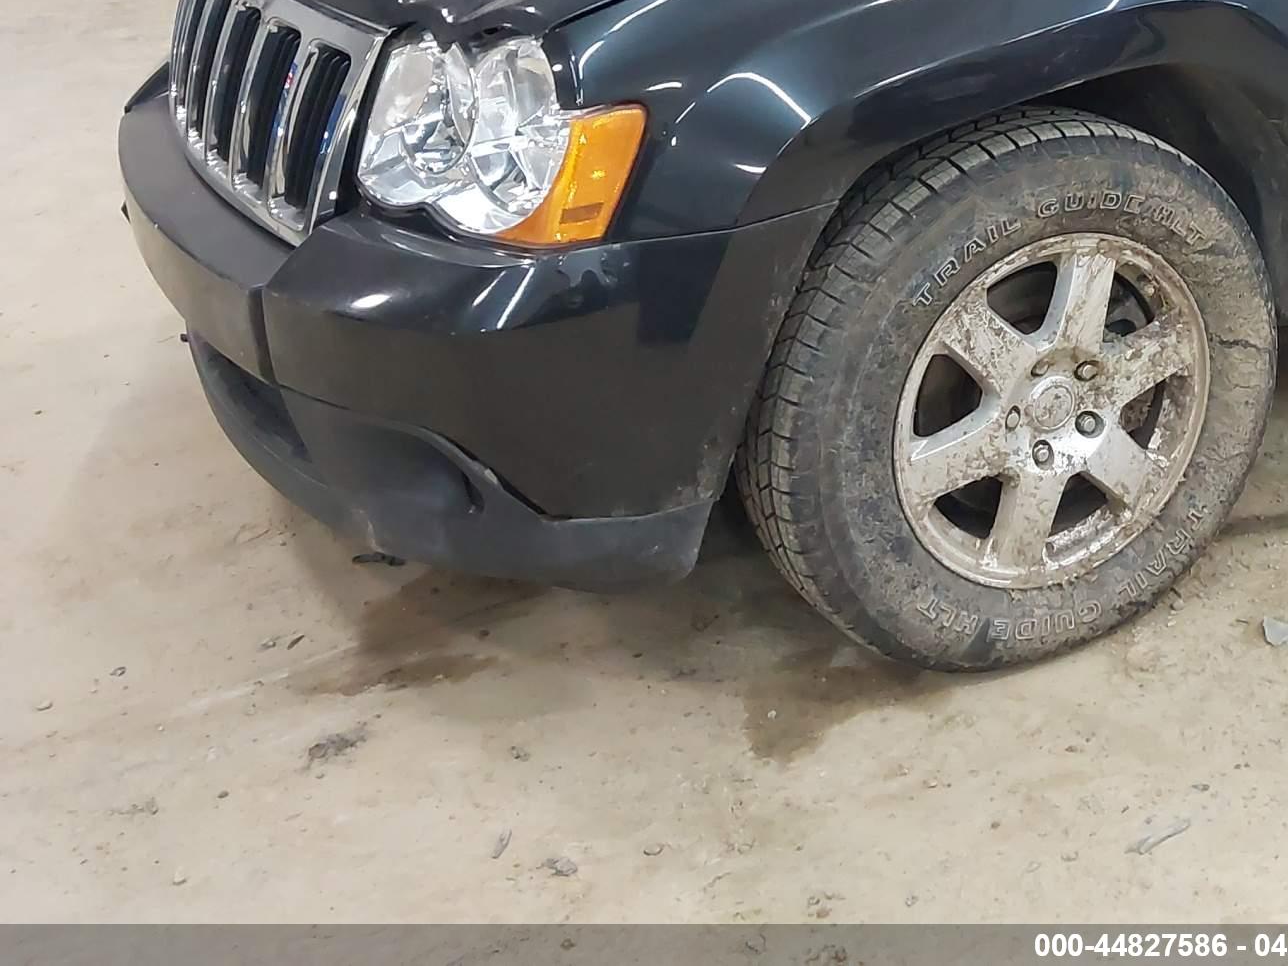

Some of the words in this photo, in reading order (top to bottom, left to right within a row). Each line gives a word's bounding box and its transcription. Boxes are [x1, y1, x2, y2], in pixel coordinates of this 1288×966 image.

[911, 215, 1022, 308] TRAIL
[1036, 191, 1146, 219] GUIDE
[1118, 505, 1209, 600] TRAIL
[988, 601, 1102, 642] GUIDE
